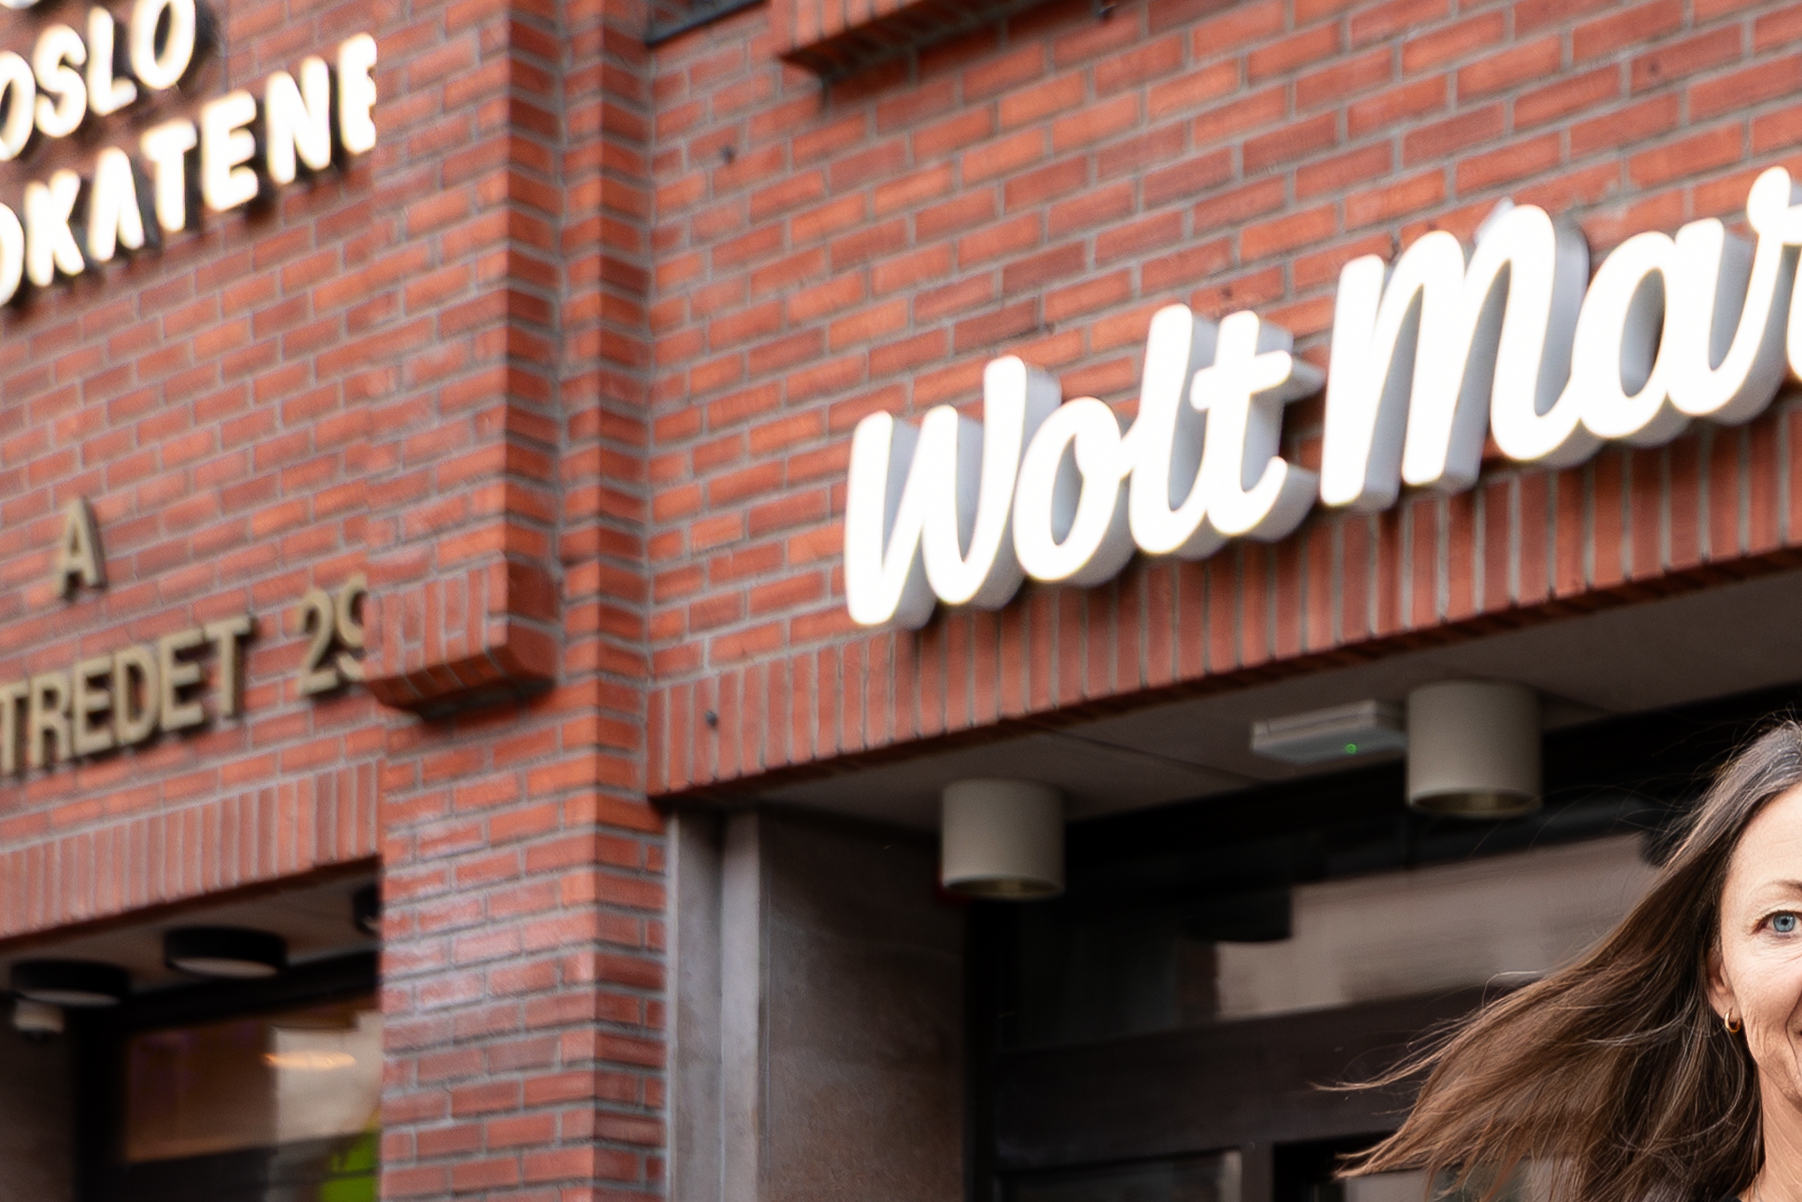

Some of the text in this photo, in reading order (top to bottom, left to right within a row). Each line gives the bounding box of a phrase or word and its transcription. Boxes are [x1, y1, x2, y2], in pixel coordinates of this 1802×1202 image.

[0, 0, 197, 161] OSLO
[845, 302, 1312, 628] Wolt
[58, 496, 107, 600] A
[0, 613, 257, 777] TREDET
